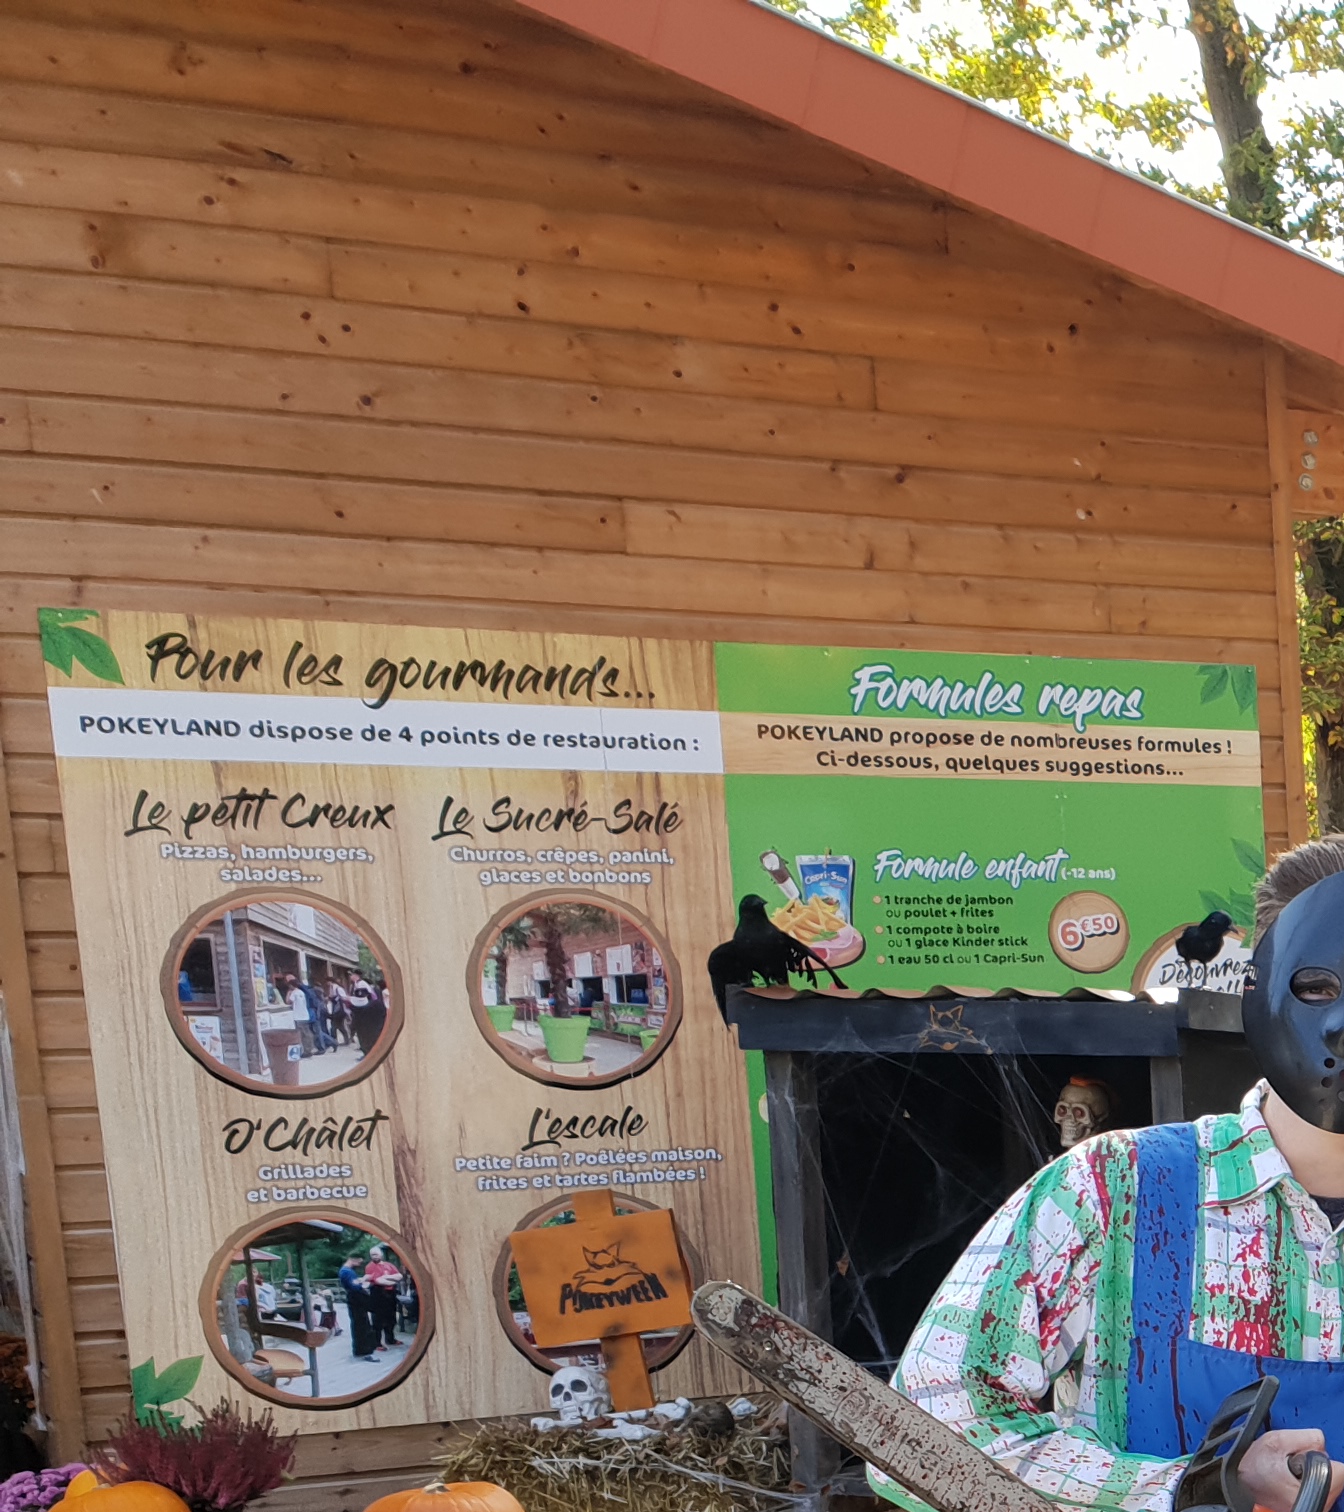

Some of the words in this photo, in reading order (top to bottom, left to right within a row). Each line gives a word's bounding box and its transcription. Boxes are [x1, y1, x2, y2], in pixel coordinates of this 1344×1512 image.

[145, 632, 263, 683] Pour
[283, 641, 344, 689] les
[361, 655, 656, 710] gourmands...
[850, 664, 1024, 718] Formules
[1036, 684, 1144, 732] repas
[79, 714, 241, 737] POKEYLAND
[249, 720, 353, 742] dispose
[361, 724, 391, 742] de
[398, 726, 413, 742] 4
[420, 727, 500, 746] points
[507, 729, 536, 746] de
[543, 732, 687, 751] restauration
[757, 723, 883, 742] POKEYLAND
[890, 731, 975, 747] propose
[980, 731, 1005, 746] de
[1011, 734, 1132, 750] nombreuses
[1138, 736, 1222, 754] formules
[816, 750, 940, 771] Ci-dessous,
[945, 755, 1040, 774] quelques
[1045, 759, 1184, 776] suggestions...
[124, 789, 172, 837] Le
[181, 787, 278, 840] petit
[281, 792, 395, 829] Creux
[431, 796, 474, 841] Le
[482, 796, 683, 835] Sucré-Salé
[160, 843, 236, 861] Pizzas,
[241, 844, 374, 863] hamburgers,
[450, 847, 532, 864] Churros,
[536, 848, 604, 865] crêpes,
[608, 849, 674, 865] panini,
[219, 866, 322, 882] salades...
[479, 868, 542, 886] glaces
[545, 868, 566, 883] et
[569, 868, 652, 884] bonbons
[874, 848, 979, 883] Formule
[984, 847, 1069, 890] enfant
[1088, 867, 1116, 881] ans)
[885, 895, 891, 905] 1
[894, 895, 943, 906] tranche
[947, 895, 962, 905] de
[965, 895, 1014, 907] jambon
[886, 909, 901, 919] ou
[904, 908, 948, 920] poulet
[960, 908, 995, 919] frites
[887, 925, 893, 935] 1
[896, 925, 953, 938] compote
[957, 923, 964, 935] à
[967, 925, 1000, 935] boire
[888, 938, 903, 948] ou
[915, 937, 950, 950] glace
[953, 937, 995, 948] Kinder
[998, 936, 1029, 948] stick
[888, 955, 894, 965] 1
[898, 956, 922, 965] eau
[925, 954, 940, 965] 50
[943, 953, 954, 965] cl
[957, 955, 972, 965] ou
[983, 953, 1045, 966] Capri-Sun
[222, 1109, 389, 1156] O'Châlet
[521, 1105, 649, 1151] L'escale
[455, 1155, 511, 1171] Petite
[515, 1152, 558, 1168] faim
[575, 1149, 647, 1166] Poêlées
[651, 1147, 722, 1162] maison,
[258, 1164, 352, 1180] Grillades
[477, 1174, 528, 1190] frites
[532, 1172, 552, 1187] et
[555, 1170, 608, 1187] tartes
[612, 1166, 696, 1184] flambées
[247, 1187, 269, 1203] et
[272, 1184, 368, 1201] barbecue
